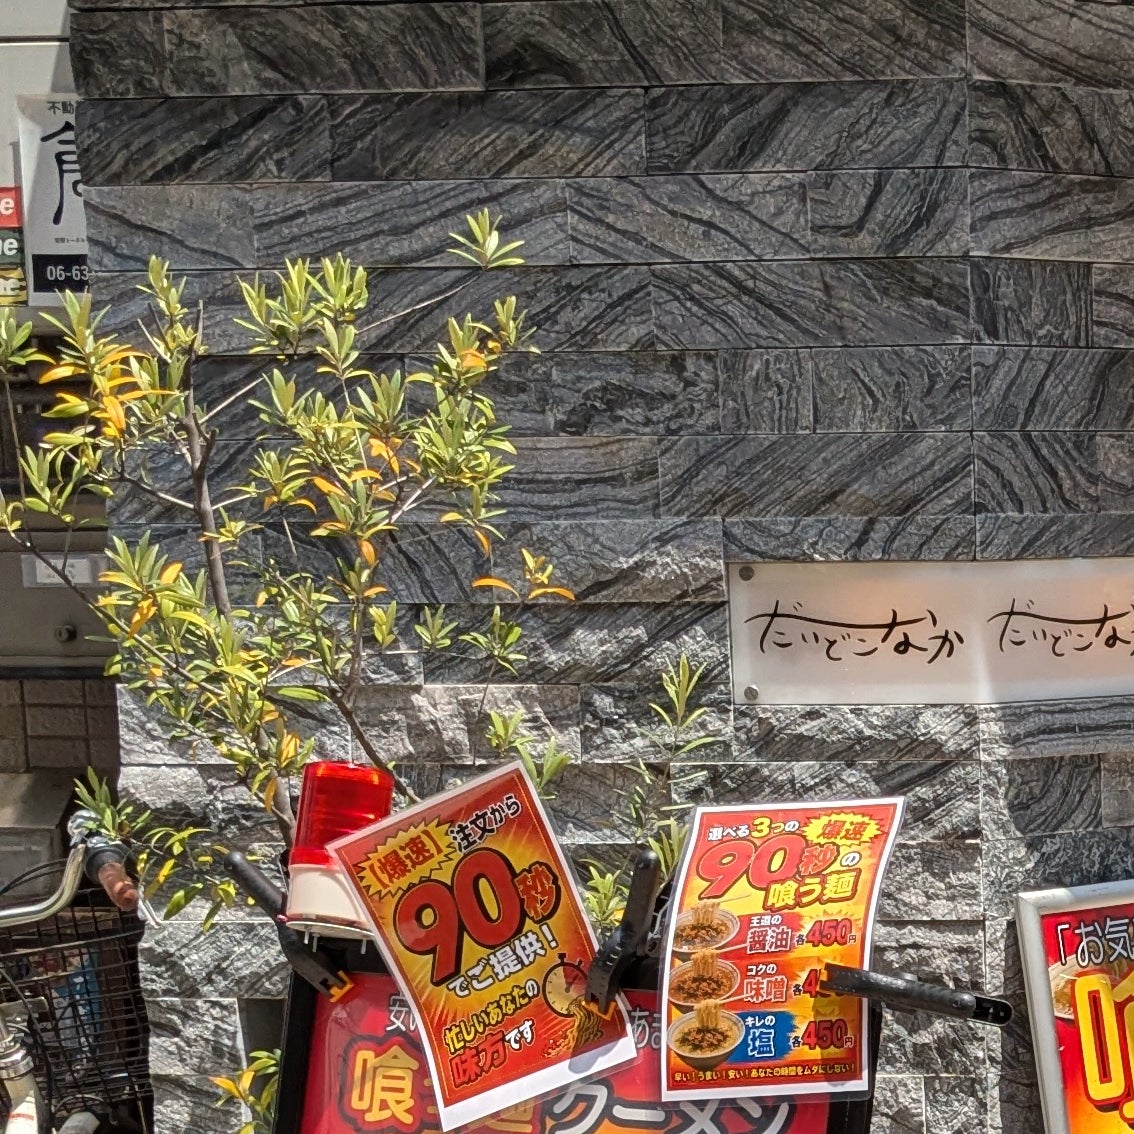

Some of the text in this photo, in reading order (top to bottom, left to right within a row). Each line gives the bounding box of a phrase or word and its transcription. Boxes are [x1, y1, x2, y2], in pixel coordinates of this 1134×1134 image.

[448, 794, 523, 853] 注文から
[747, 926, 792, 954] 醤油
[746, 963, 777, 976] コクの
[743, 975, 788, 1004] 味噌
[444, 980, 540, 1054] 忙しいあなたの
[745, 1015, 776, 1027] キレの
[450, 1018, 535, 1088] 味方です
[747, 1028, 775, 1057] 塩
